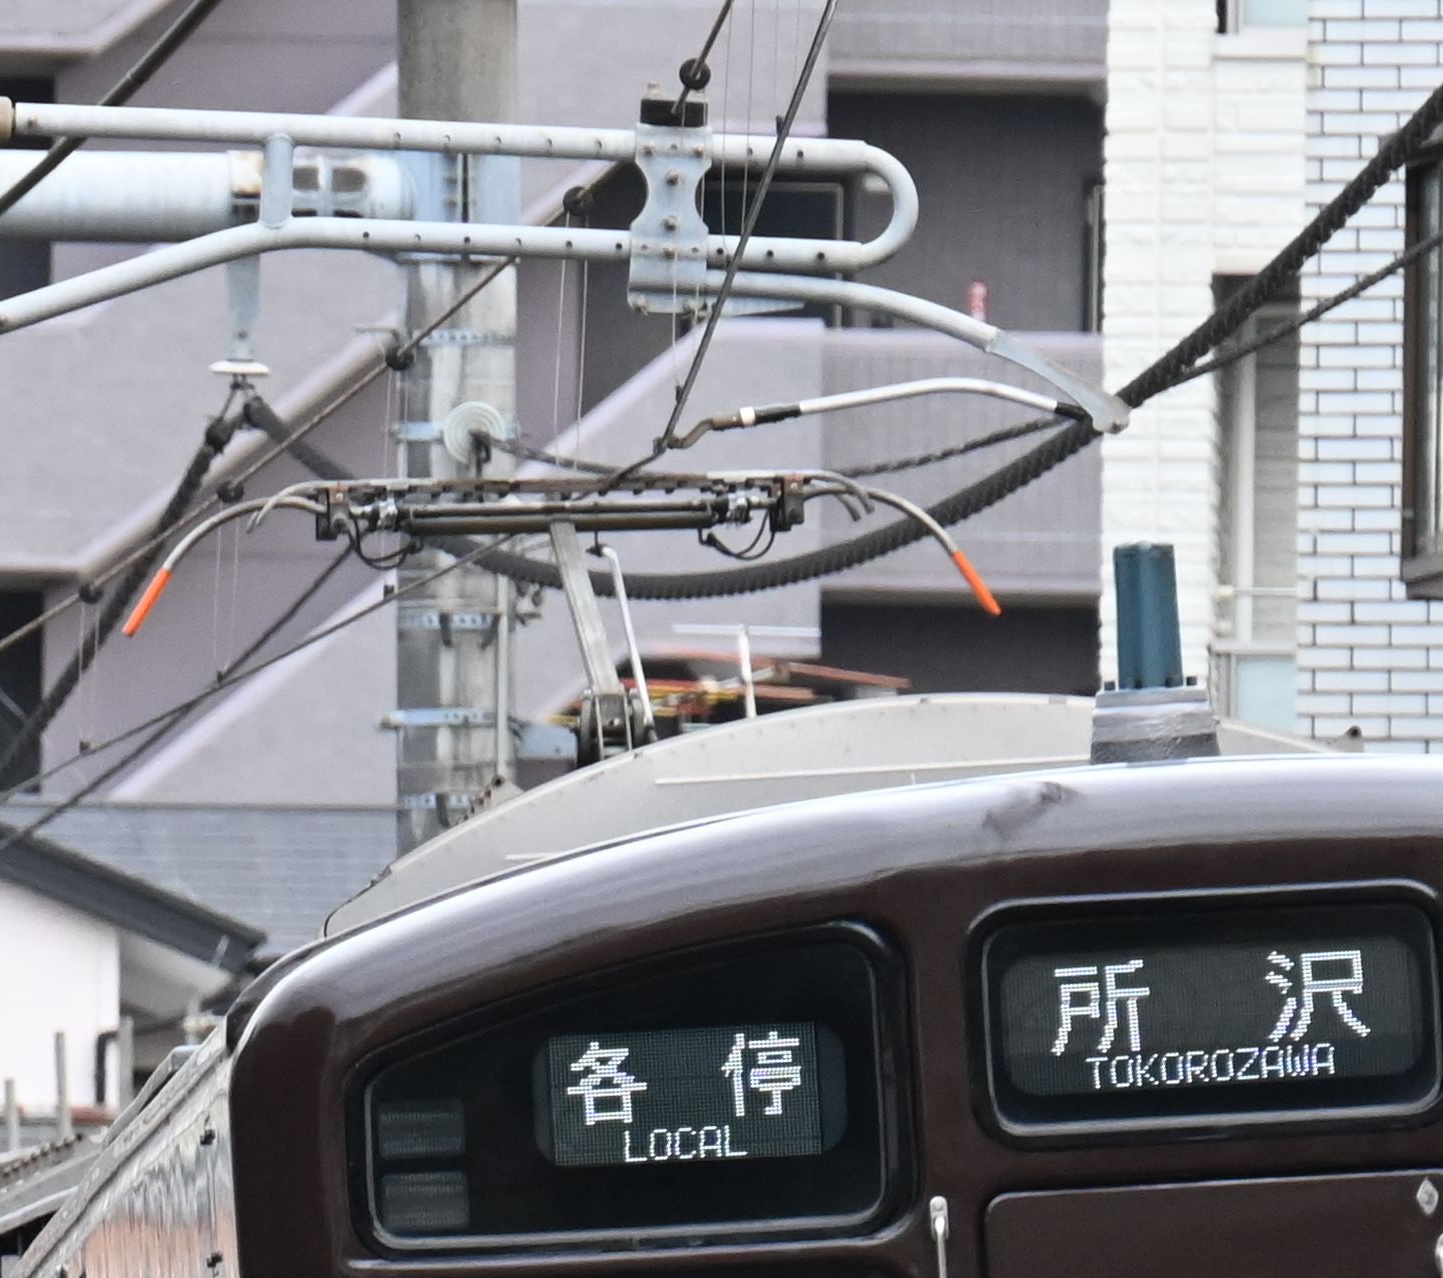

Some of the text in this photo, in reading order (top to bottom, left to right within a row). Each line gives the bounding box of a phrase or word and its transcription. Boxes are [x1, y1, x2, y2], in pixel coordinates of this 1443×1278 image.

[1052, 949, 1371, 1056] 所沢
[567, 1031, 802, 1125] 各停
[1086, 1043, 1336, 1089] TOKOROZAWA
[624, 1125, 748, 1163] LOCAL
